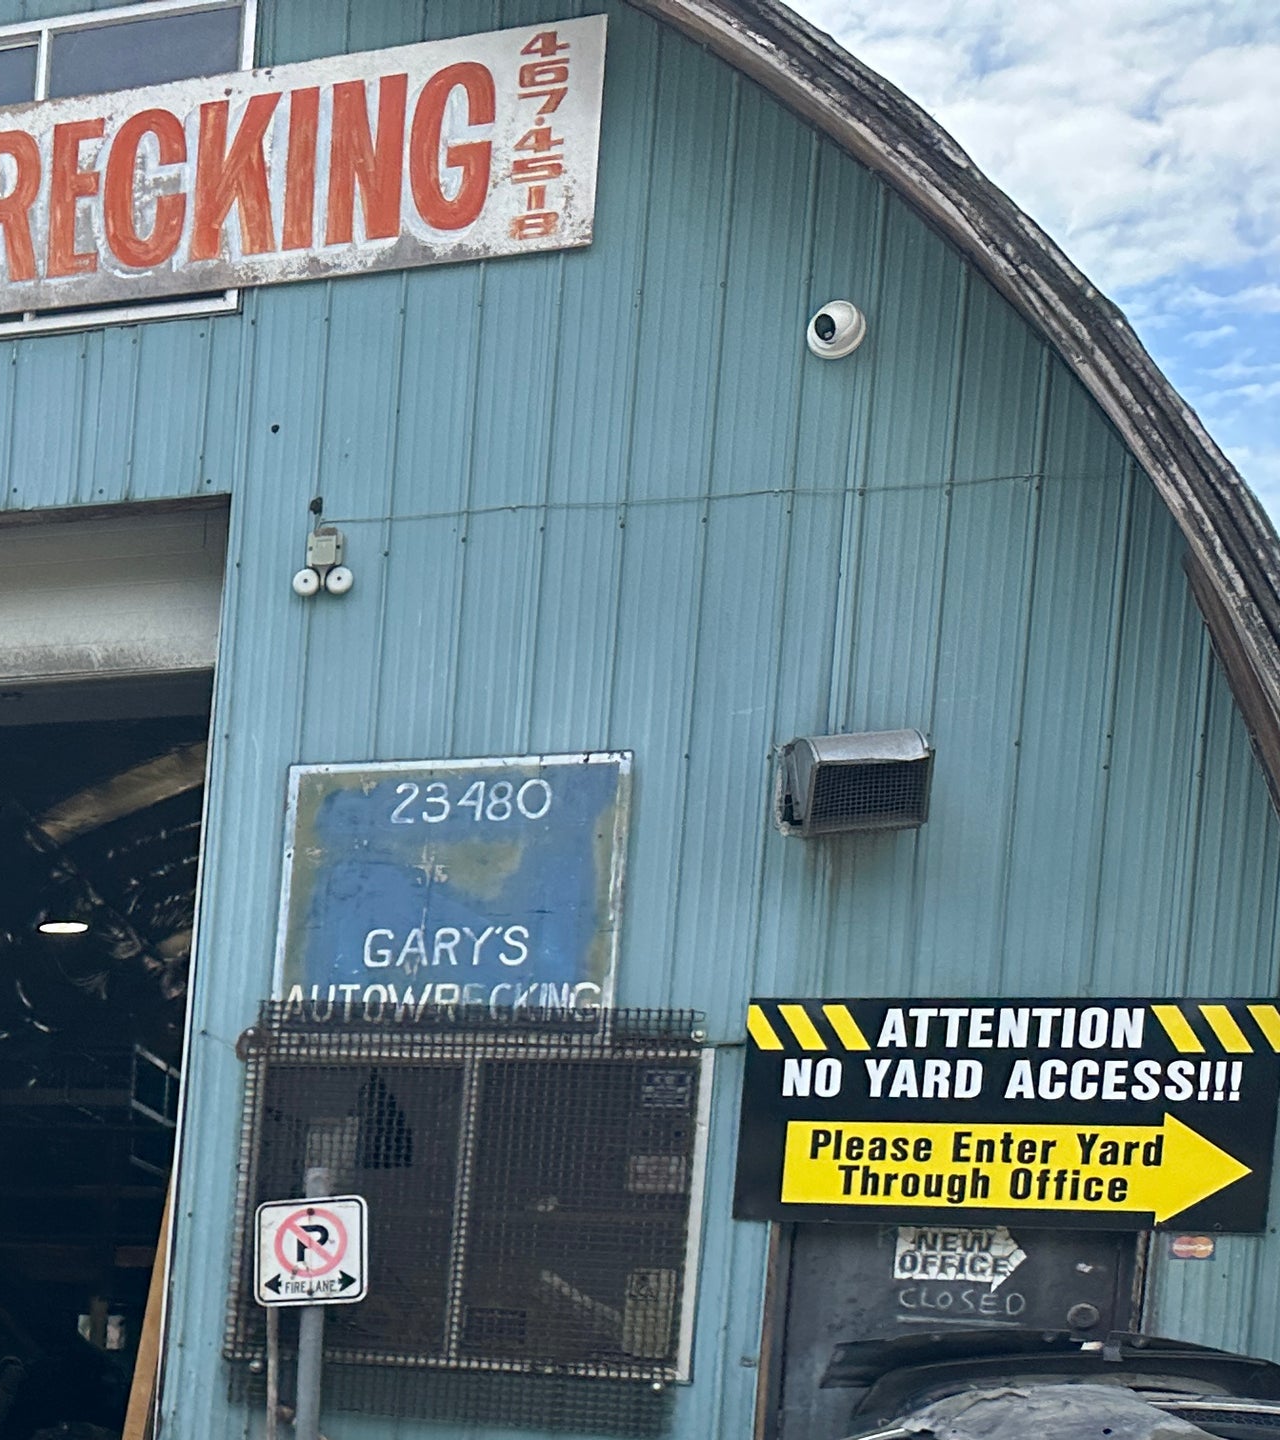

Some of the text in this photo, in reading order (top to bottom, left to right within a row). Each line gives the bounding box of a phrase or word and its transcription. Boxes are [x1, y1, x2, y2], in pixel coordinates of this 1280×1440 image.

[389, 778, 554, 825] 23480
[362, 924, 529, 969] GARY'S
[876, 1006, 1146, 1049] ATTENTION
[781, 1057, 1243, 1101] NO YARD ACCESS!!!
[809, 1128, 1165, 1167] Please Enter Yard
[838, 1164, 1129, 1204] Through Office
[916, 1230, 996, 1252] NEW
[898, 1249, 1011, 1276] OFFICE
[284, 1279, 338, 1294] FIRE LANE
[898, 1286, 1026, 1316] CLOSED
